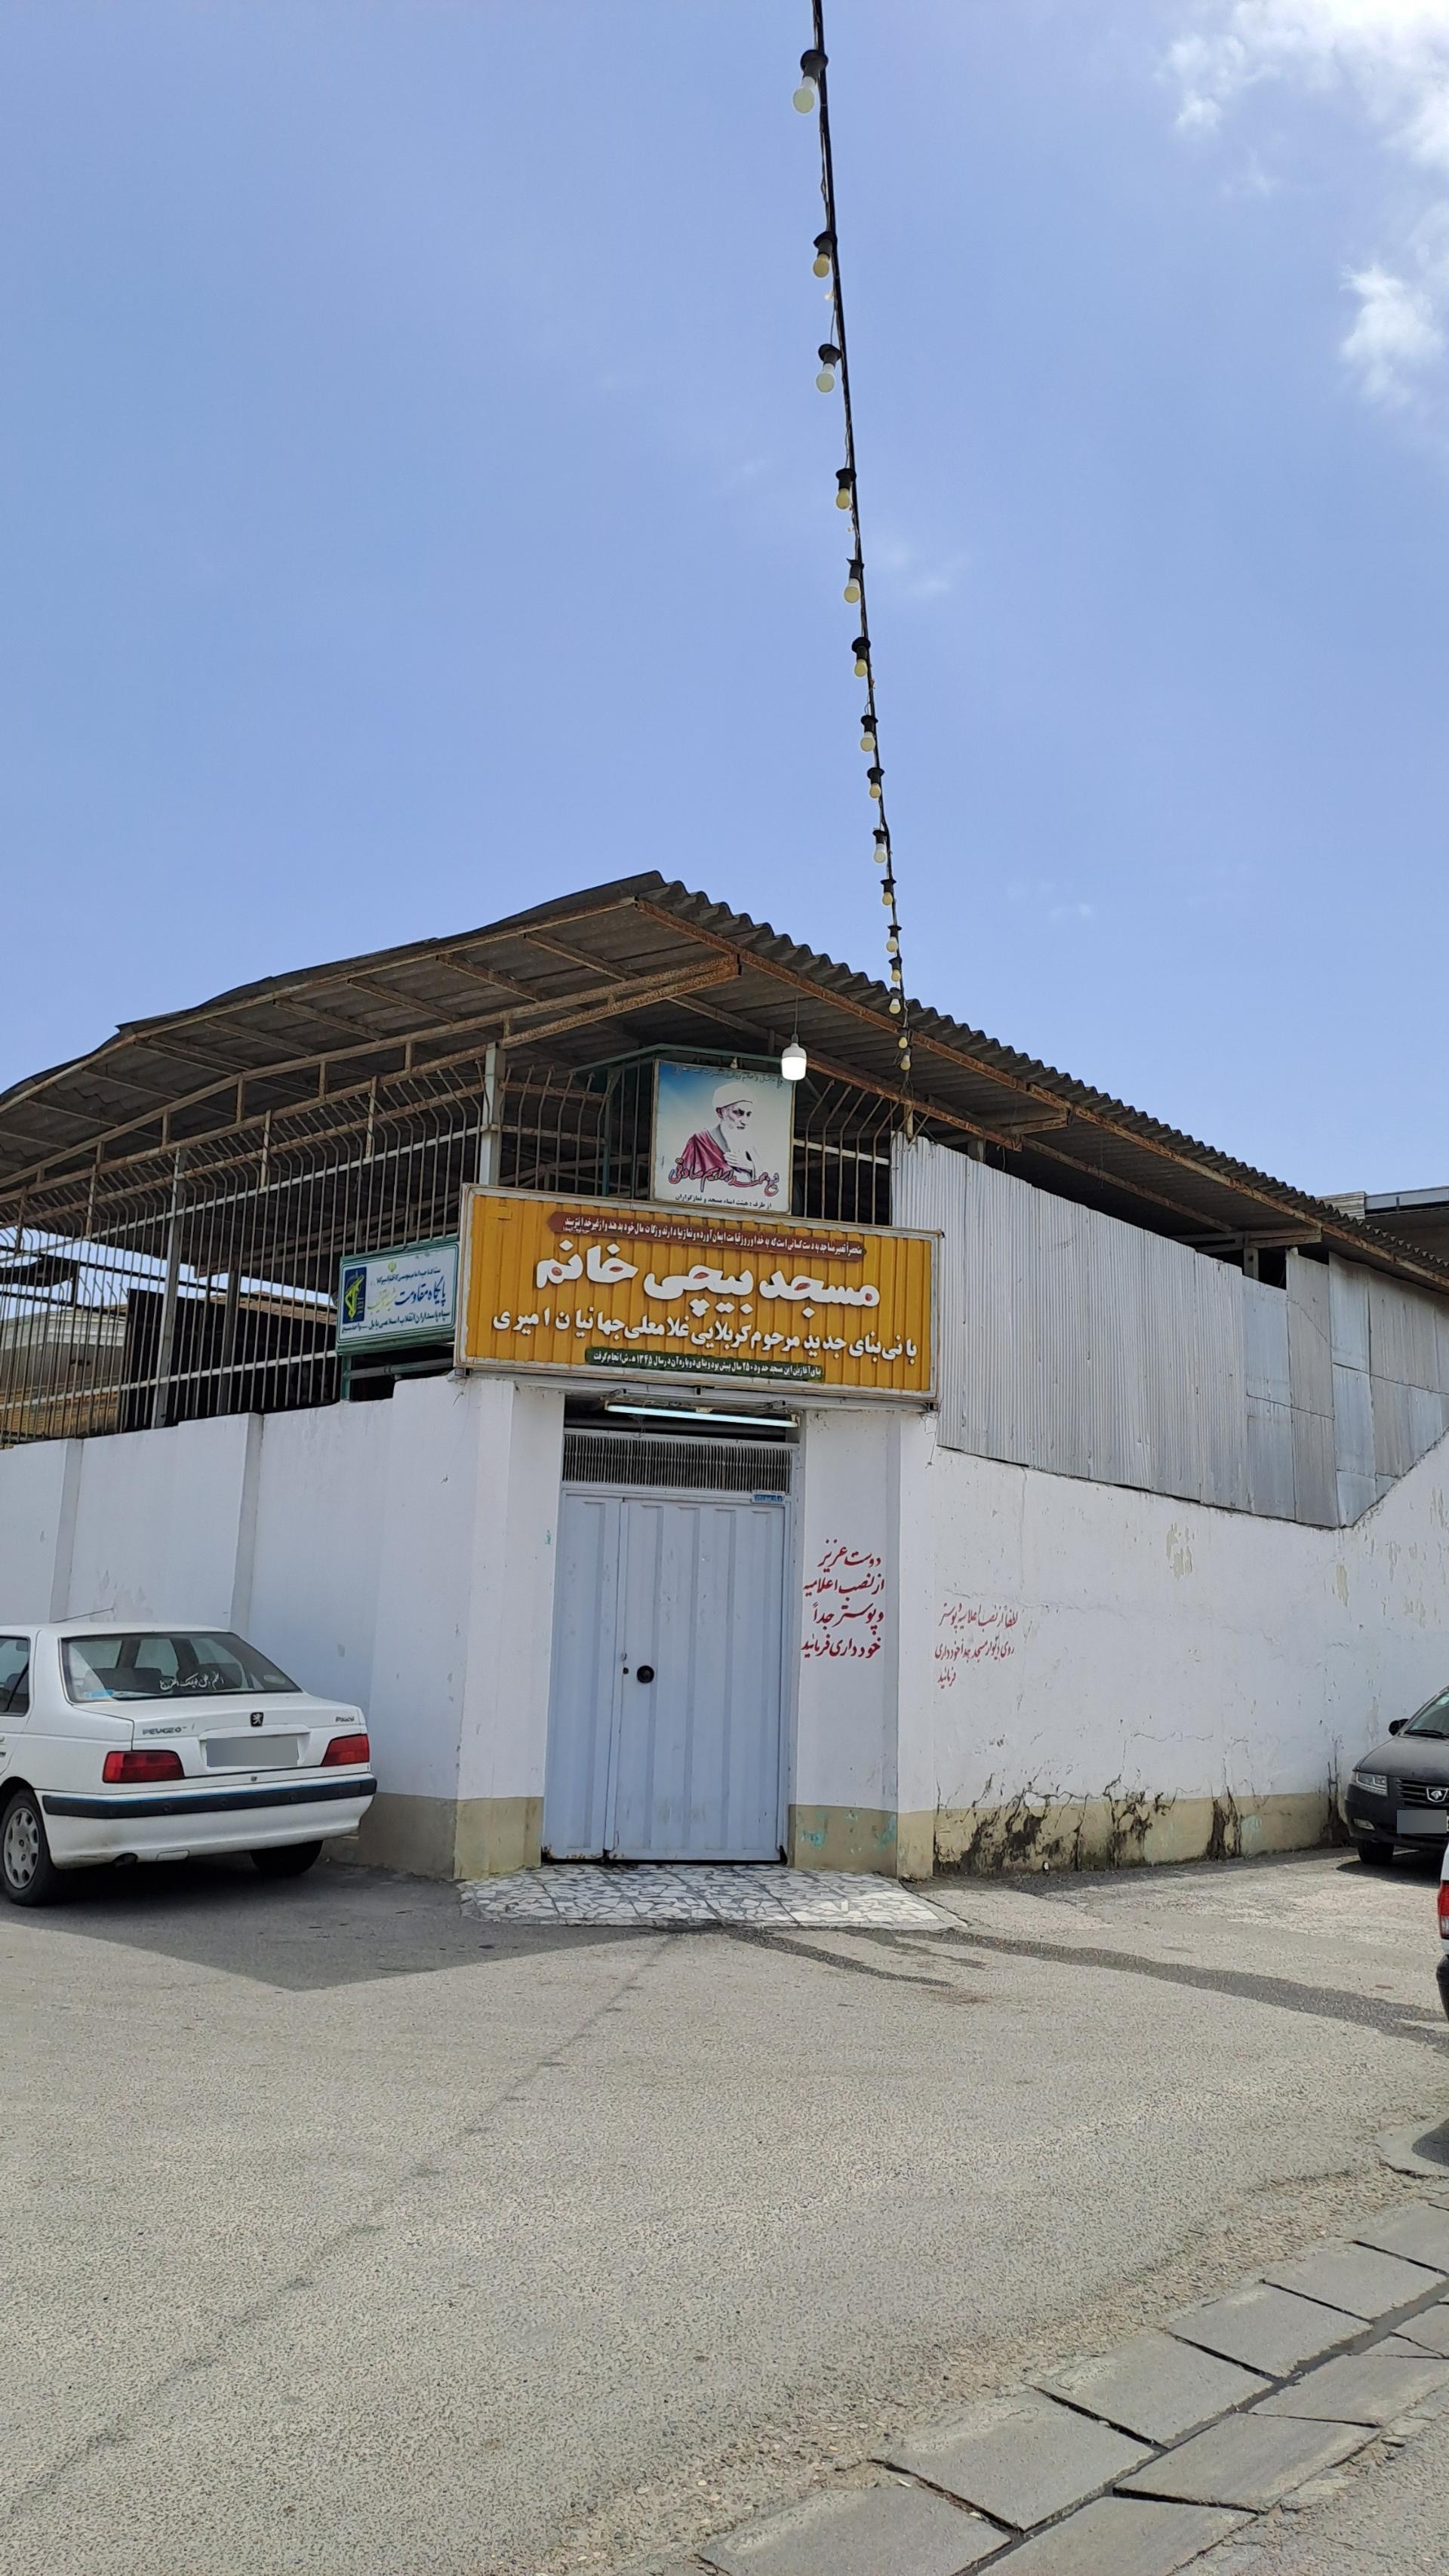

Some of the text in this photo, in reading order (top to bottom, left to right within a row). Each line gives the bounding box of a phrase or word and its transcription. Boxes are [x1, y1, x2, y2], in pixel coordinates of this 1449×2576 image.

[668, 1158, 704, 1184] صادقی
[700, 1166, 734, 1193] ابراهیم
[752, 1200, 765, 1208] طرف
[581, 1217, 592, 1227] خدا
[591, 1218, 599, 1230] غیر
[623, 1221, 635, 1234] خود
[635, 1222, 644, 1234] مال
[645, 1223, 658, 1237] زکات
[662, 1226, 676, 1238] دارند
[682, 1227, 693, 1240] نماز
[712, 1231, 726, 1243] ایمان
[727, 1232, 740, 1245] قیامت
[740, 1236, 751, 1246] روز
[754, 1235, 764, 1245] خدا
[771, 1237, 777, 1246] که
[777, 1238, 787, 1248] است
[788, 1239, 803, 1251] کسانی
[802, 1242, 814, 1250] دست
[536, 1239, 639, 1288] خانم
[395, 1283, 429, 1306] مقاومت
[427, 1276, 447, 1306] پایگاه
[758, 1270, 881, 1319] مسجد
[493, 1306, 918, 1365] بانی بنای جدید مرحوم کربلایی غلامعلی جهانیان امیری
[593, 1351, 608, 1363] گرفت
[607, 1353, 622, 1363] انجام
[654, 1355, 664, 1365] سال
[671, 1356, 679, 1367] آن
[679, 1358, 696, 1368] دوباره
[719, 1361, 731, 1372] پیش
[731, 1361, 742, 1372] سال
[754, 1363, 768, 1374] حدود
[769, 1365, 783, 1375] مسجد
[783, 1365, 792, 1375] این
[817, 1539, 881, 1572] دوست عزیز
[803, 1573, 884, 1601] از نصب اعلامیه
[832, 1602, 878, 1635] پوستر
[876, 1611, 884, 1622] و
[938, 1602, 958, 1633] پوستر
[997, 1605, 1004, 1627] از
[971, 1640, 989, 1663] مسجد
[985, 1641, 1000, 1660] دیوار
[1001, 1641, 1014, 1658] روی
